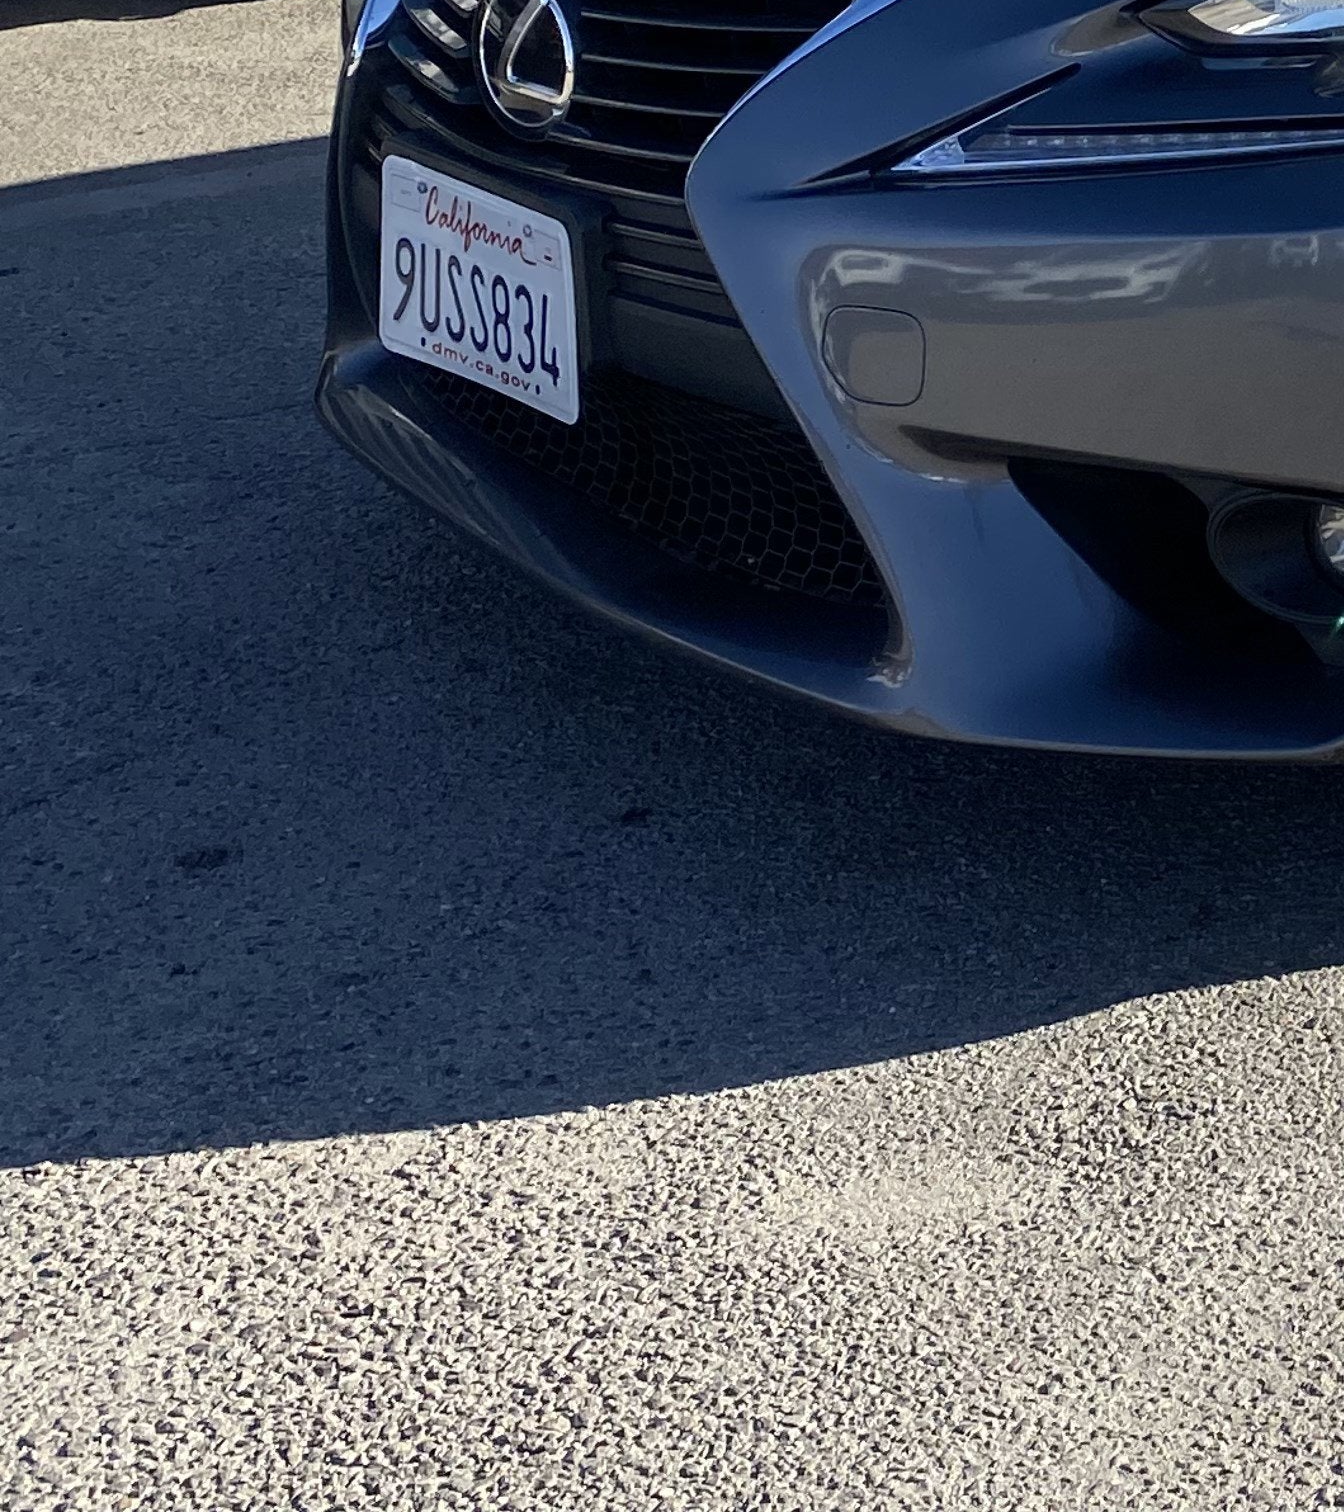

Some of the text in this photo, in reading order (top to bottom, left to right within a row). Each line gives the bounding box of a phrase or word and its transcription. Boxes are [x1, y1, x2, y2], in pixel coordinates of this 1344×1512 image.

[425, 185, 537, 266] California
[393, 237, 560, 387] 9USS834
[431, 342, 532, 392] dmv.ca.gov
